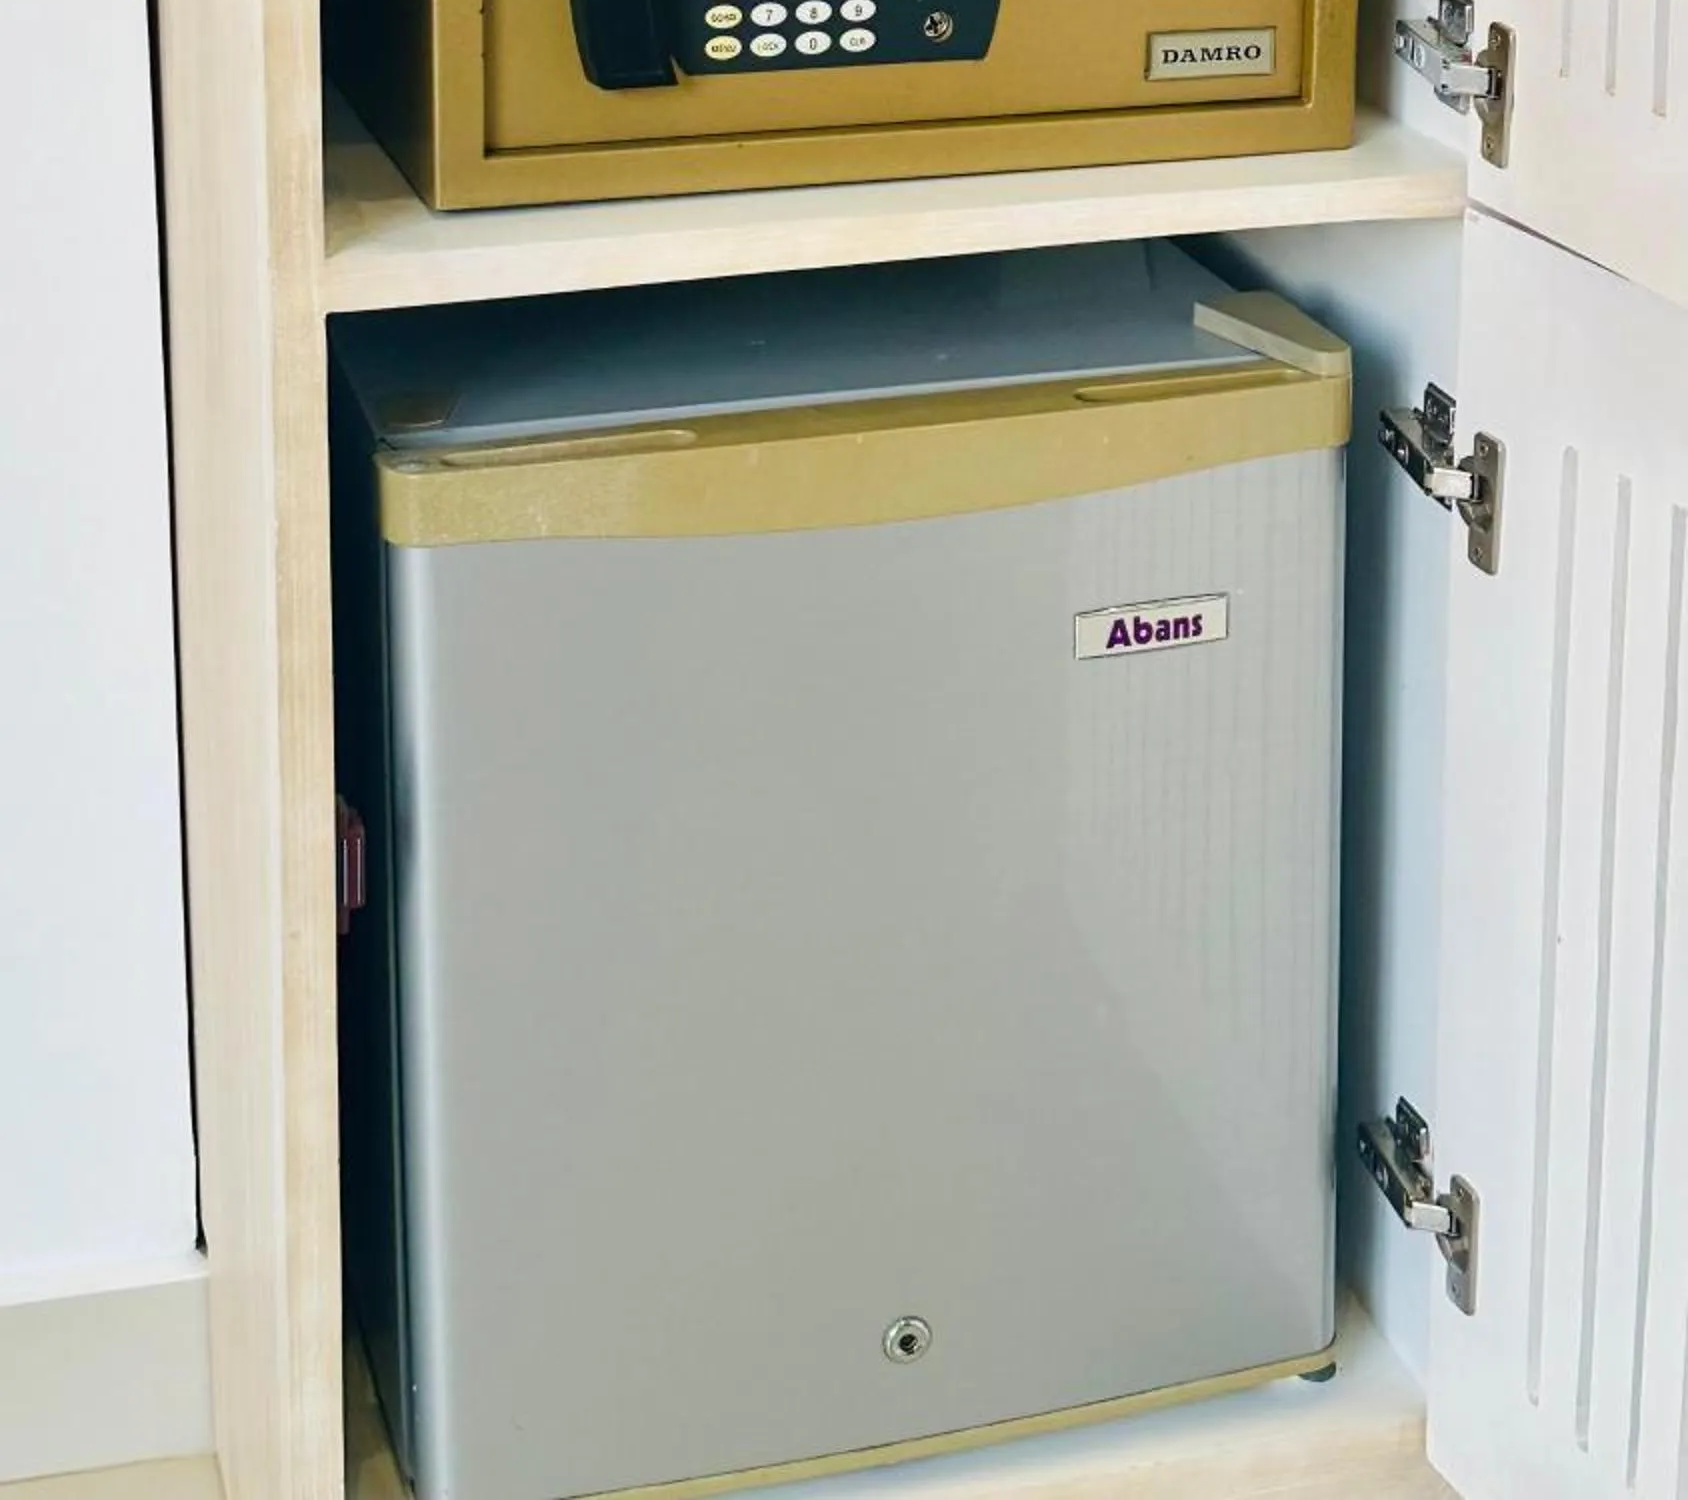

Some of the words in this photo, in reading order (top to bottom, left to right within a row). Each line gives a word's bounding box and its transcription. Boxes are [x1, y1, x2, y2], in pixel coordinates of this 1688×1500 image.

[764, 9, 774, 21] 7
[809, 7, 818, 19] 8
[854, 4, 863, 17] 9
[1161, 45, 1262, 64] DAMRO
[1106, 613, 1203, 649] Abans
